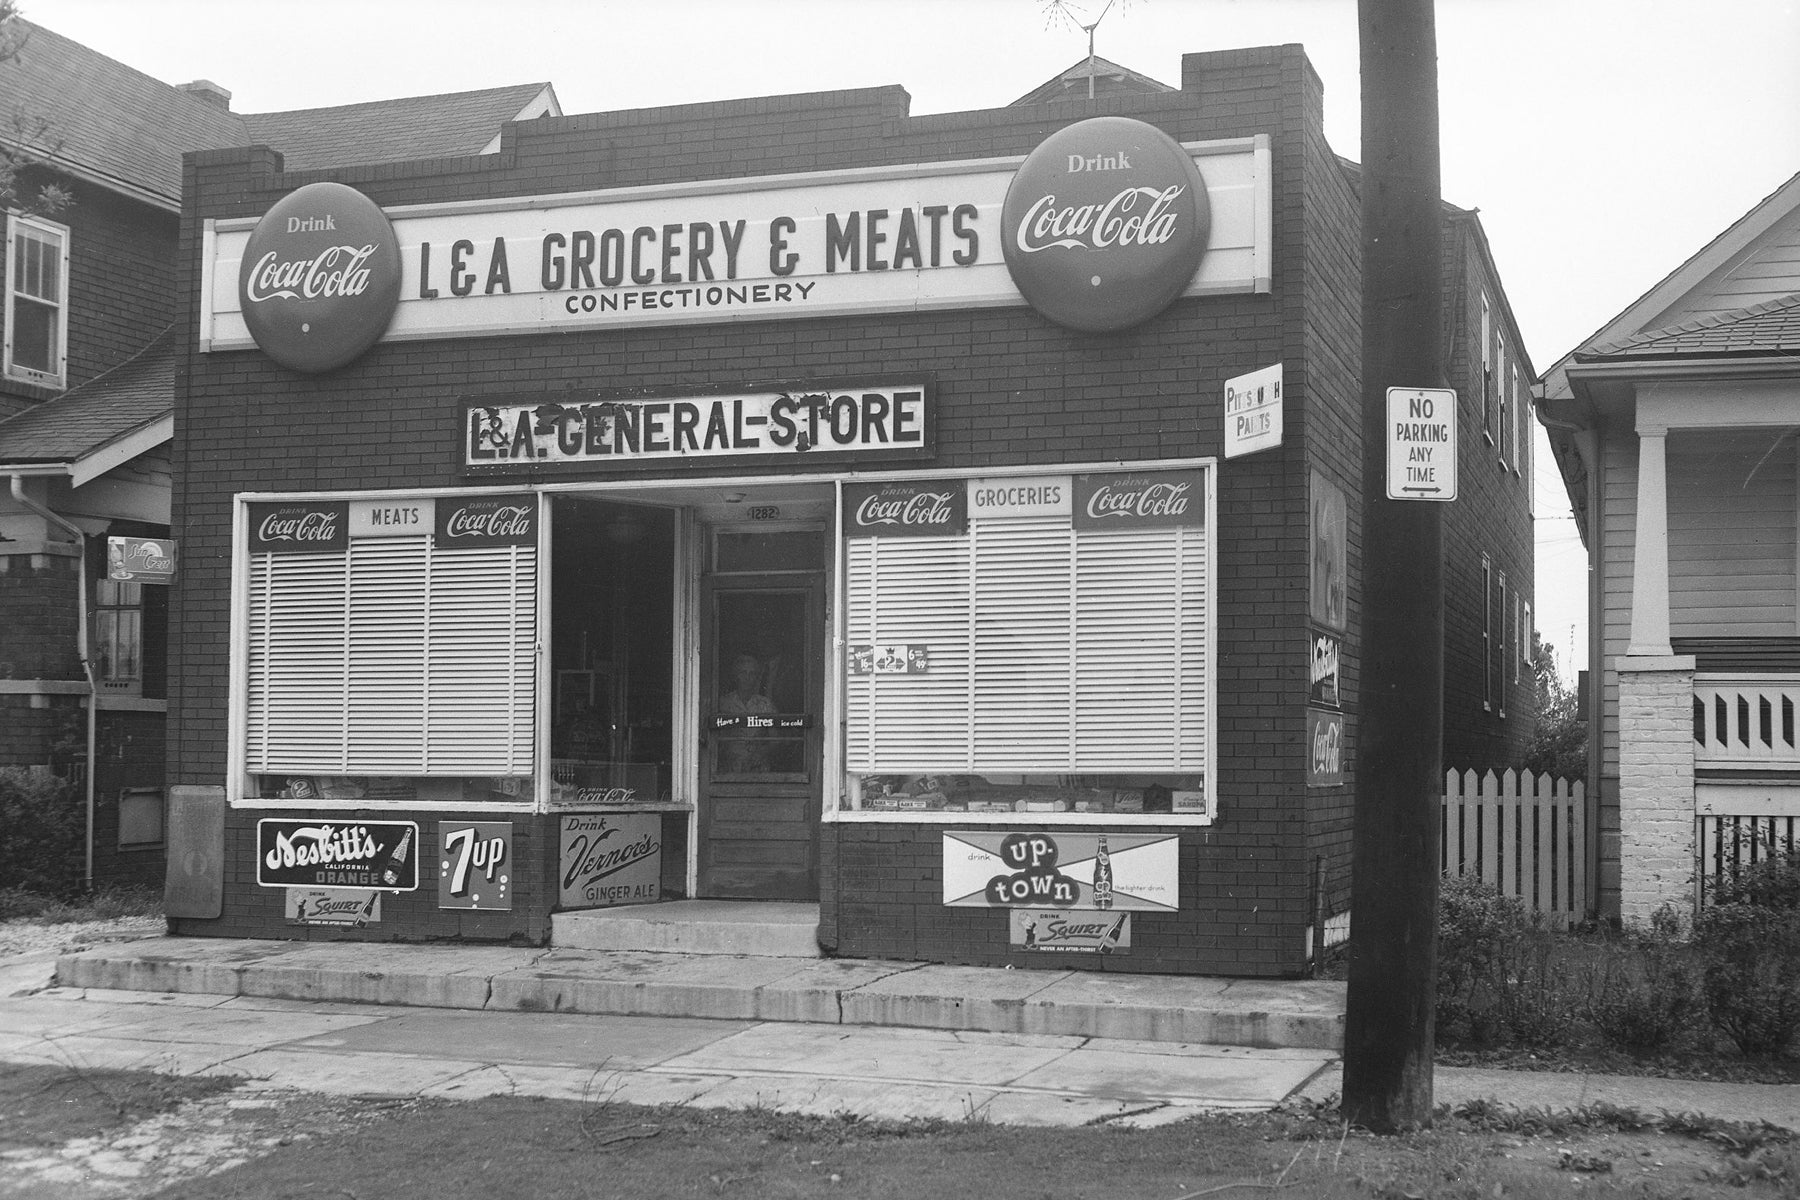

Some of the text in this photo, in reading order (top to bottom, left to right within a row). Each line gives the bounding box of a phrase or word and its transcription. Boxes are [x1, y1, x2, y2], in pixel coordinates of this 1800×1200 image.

[1067, 152, 1132, 174] Drink
[287, 215, 336, 233] Drink
[1017, 183, 1186, 254] Coca-Cola
[542, 219, 746, 290] GROCERY
[769, 217, 799, 276] &
[826, 204, 978, 273] MEATS
[248, 242, 380, 302] Coca-Cola
[565, 281, 816, 314] CONFECTIONERY
[1409, 399, 1434, 419] NO
[1396, 423, 1448, 443] PARKING
[1408, 447, 1433, 463] ANY
[1406, 467, 1436, 483] TIME
[975, 485, 1062, 508] GROCERIES
[1086, 481, 1192, 518] Coca-Cola
[372, 508, 420, 526] MEATS
[752, 508, 775, 519] 1282
[855, 492, 957, 527] Coca-Cola
[258, 512, 340, 542] Coca-Cola
[446, 505, 534, 538] Coca-Cola
[747, 716, 774, 727] Hires
[565, 818, 607, 831] Drink
[266, 825, 376, 869] Nesbitt's
[967, 853, 991, 861] drink
[316, 871, 379, 885] ORANGE
[586, 884, 654, 900] GINGER ALE
